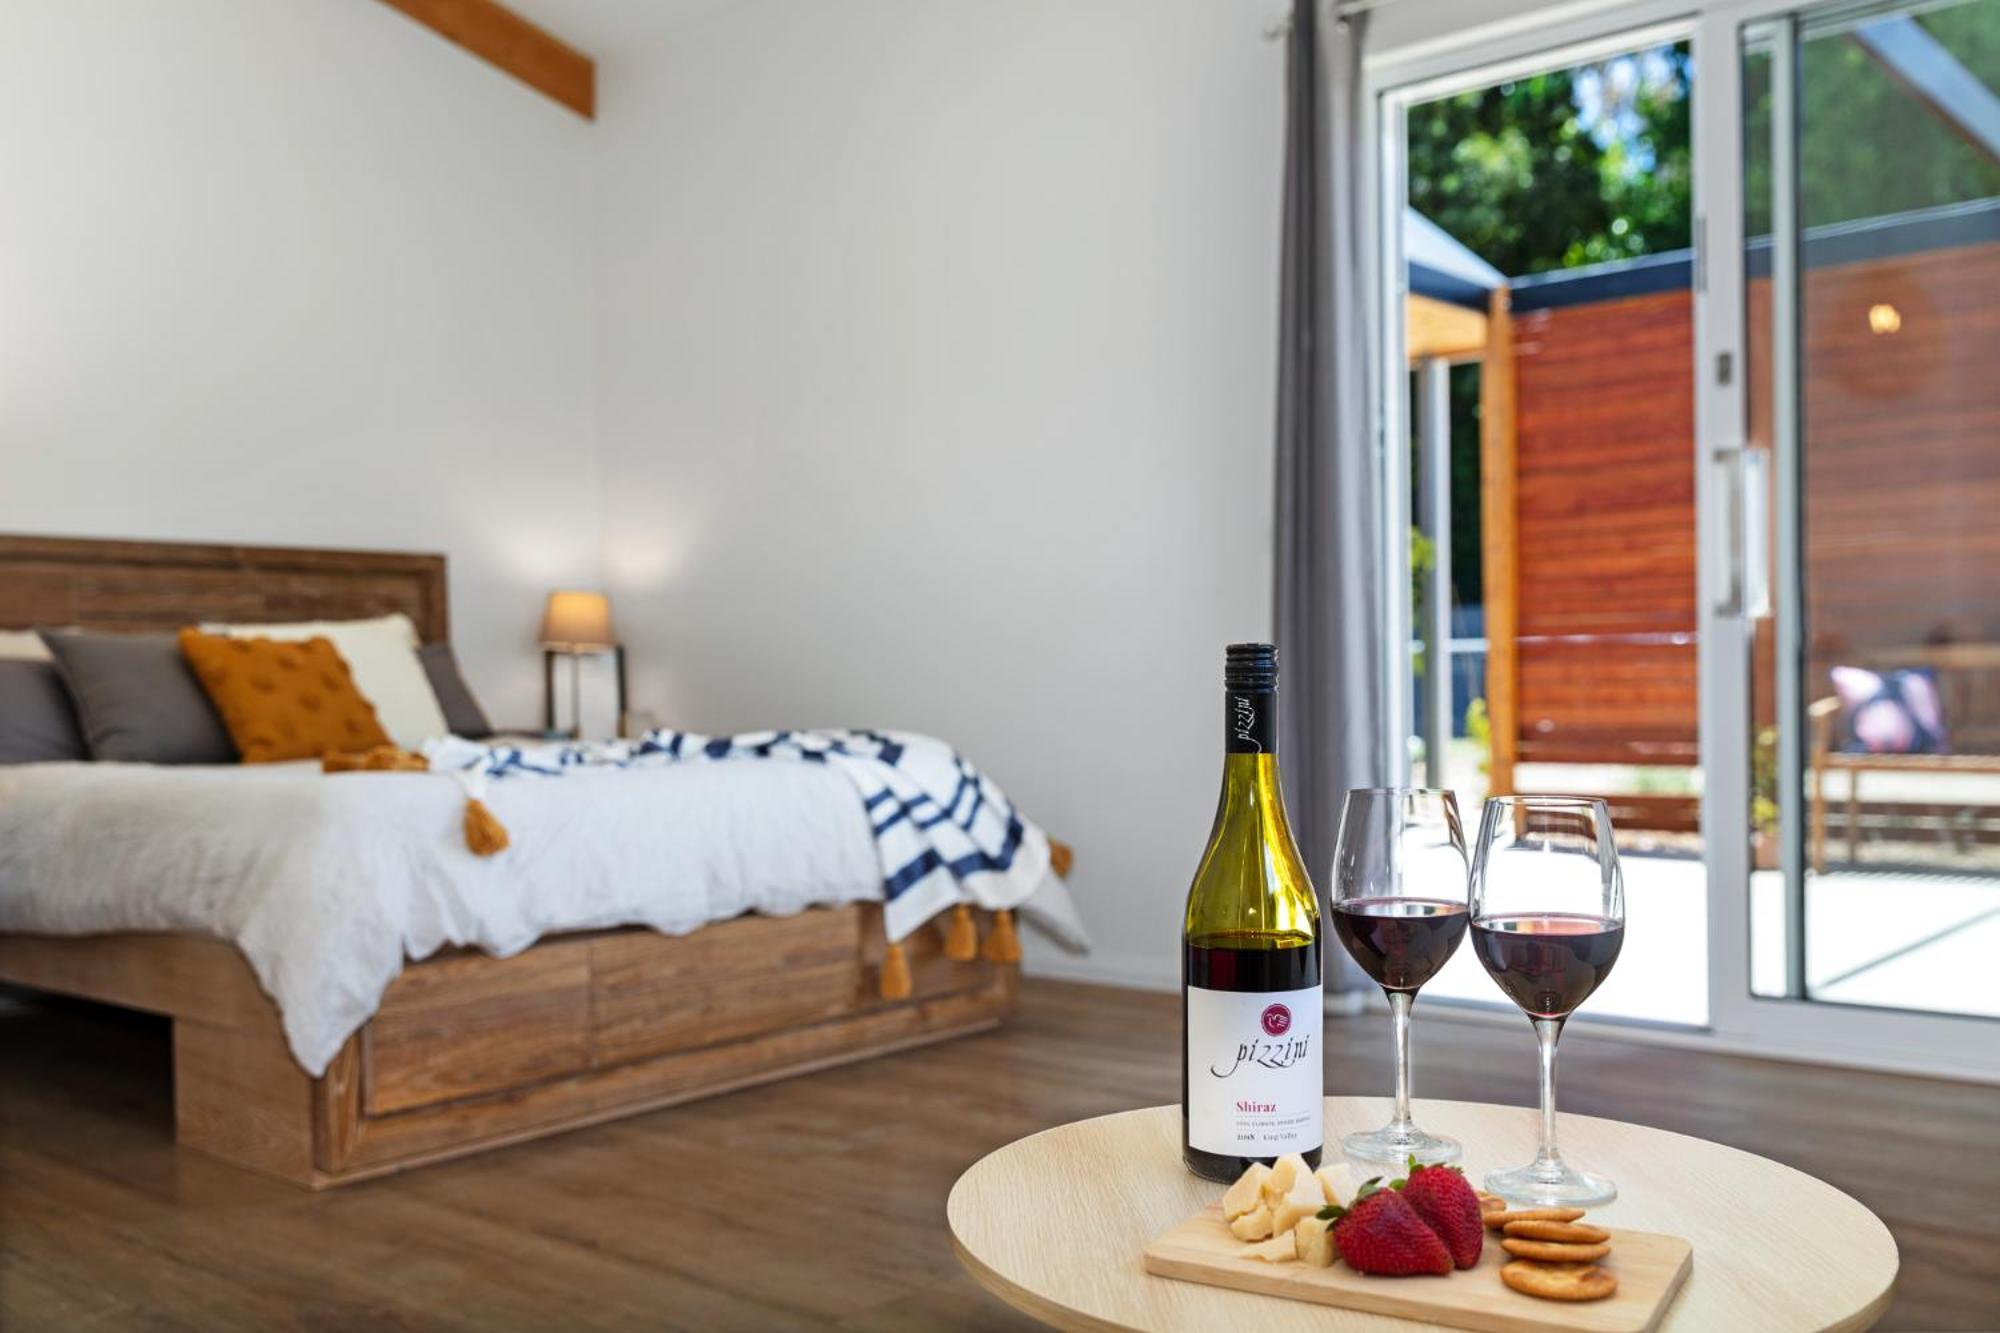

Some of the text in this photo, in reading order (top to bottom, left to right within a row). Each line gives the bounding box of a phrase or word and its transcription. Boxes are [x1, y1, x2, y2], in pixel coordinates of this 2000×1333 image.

[1234, 696, 1262, 753] pizzini
[1210, 1035, 1310, 1078] pizzini
[1236, 1101, 1277, 1113] Shiraz
